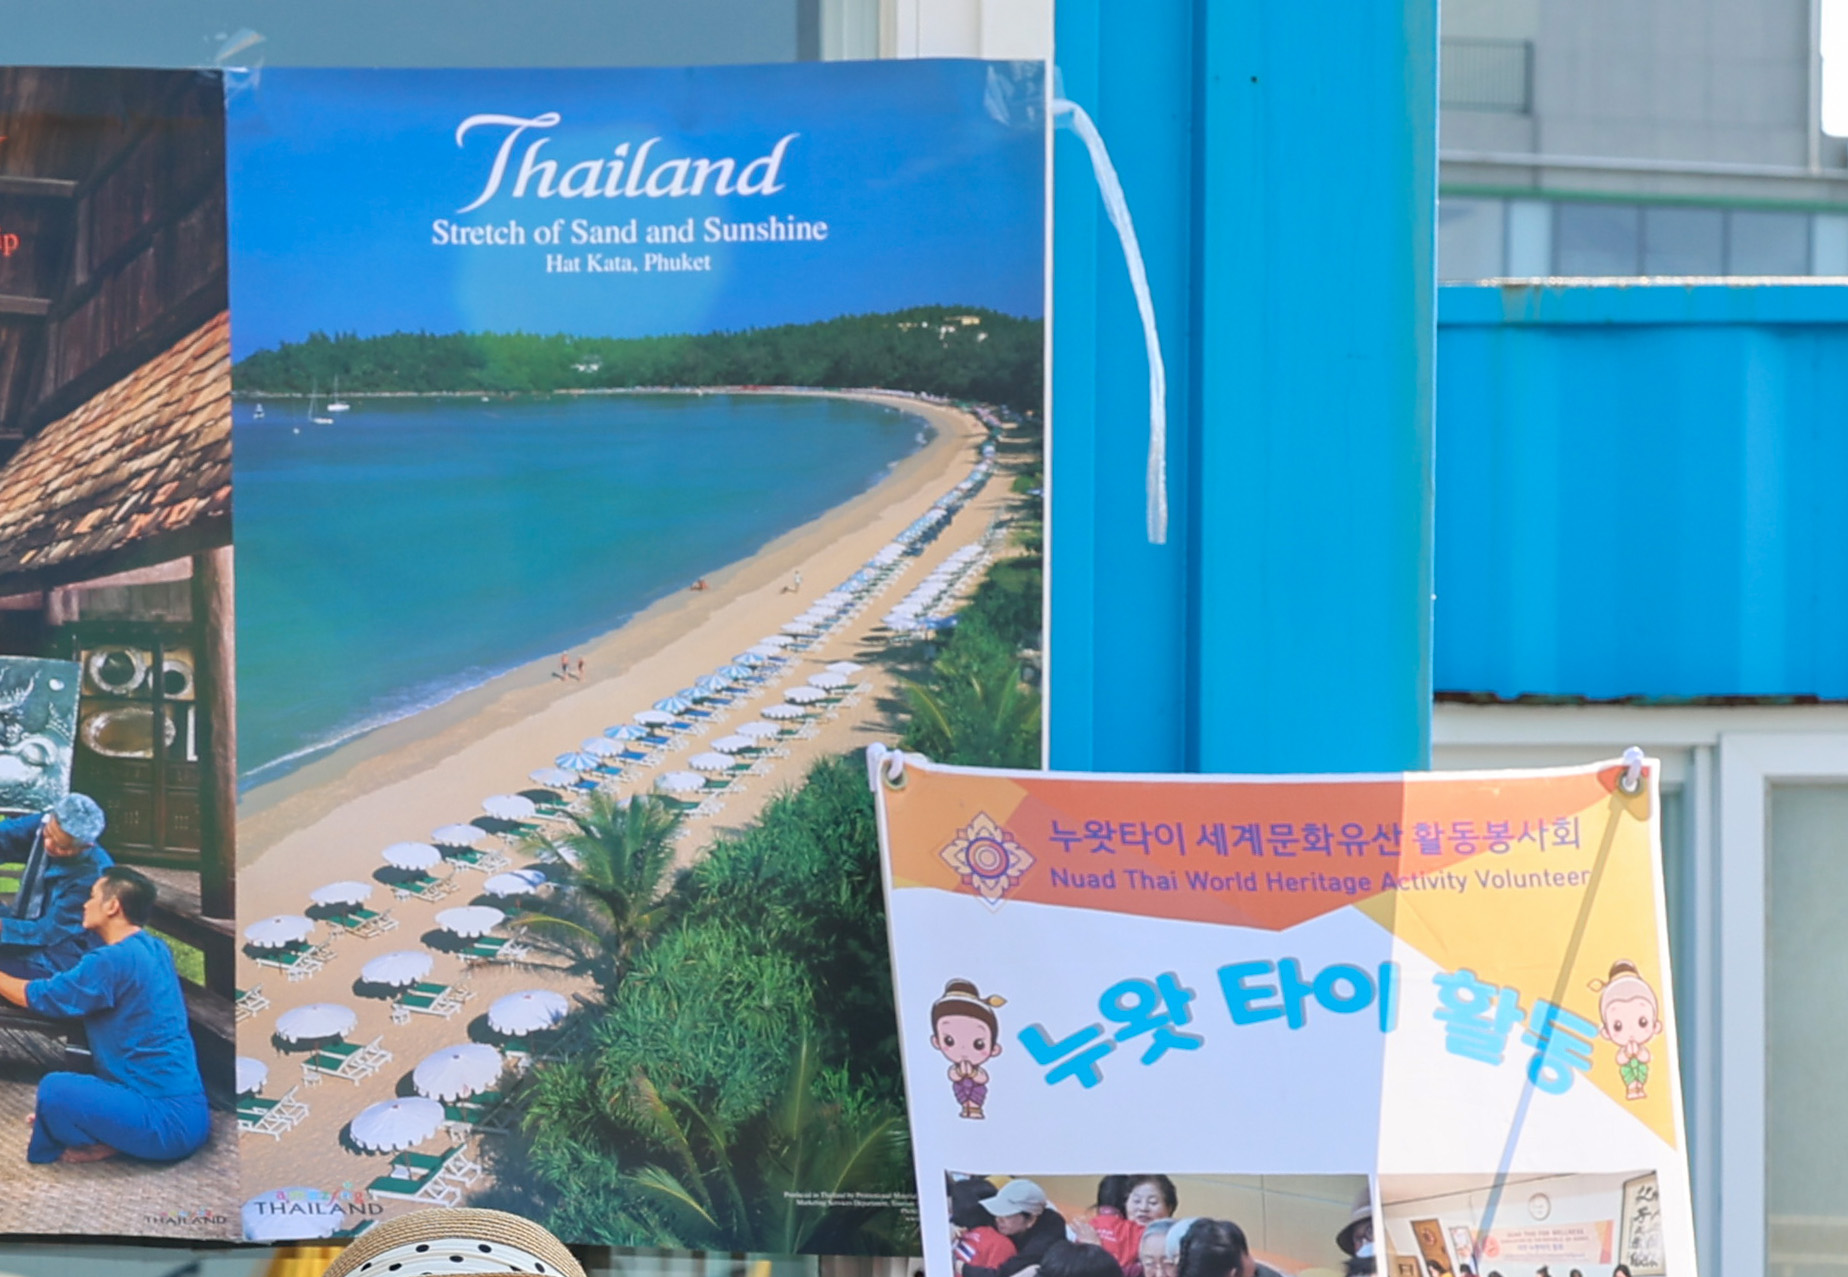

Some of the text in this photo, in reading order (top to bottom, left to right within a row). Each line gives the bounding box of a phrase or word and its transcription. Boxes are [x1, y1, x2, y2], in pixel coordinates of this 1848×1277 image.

[455, 112, 802, 214] Thailand
[431, 215, 828, 246] Stretch of Sand and Sunshine
[546, 252, 712, 274] Hat Kata, Phuket
[1048, 816, 1582, 858] 누왓타이 세계문화유산 활동봉사회
[1051, 867, 1591, 895] Nuad Thai World Heritage Activity Volunteer
[1017, 957, 1601, 1095] 누왓 타이 활동
[255, 1201, 384, 1216] THAILAND
